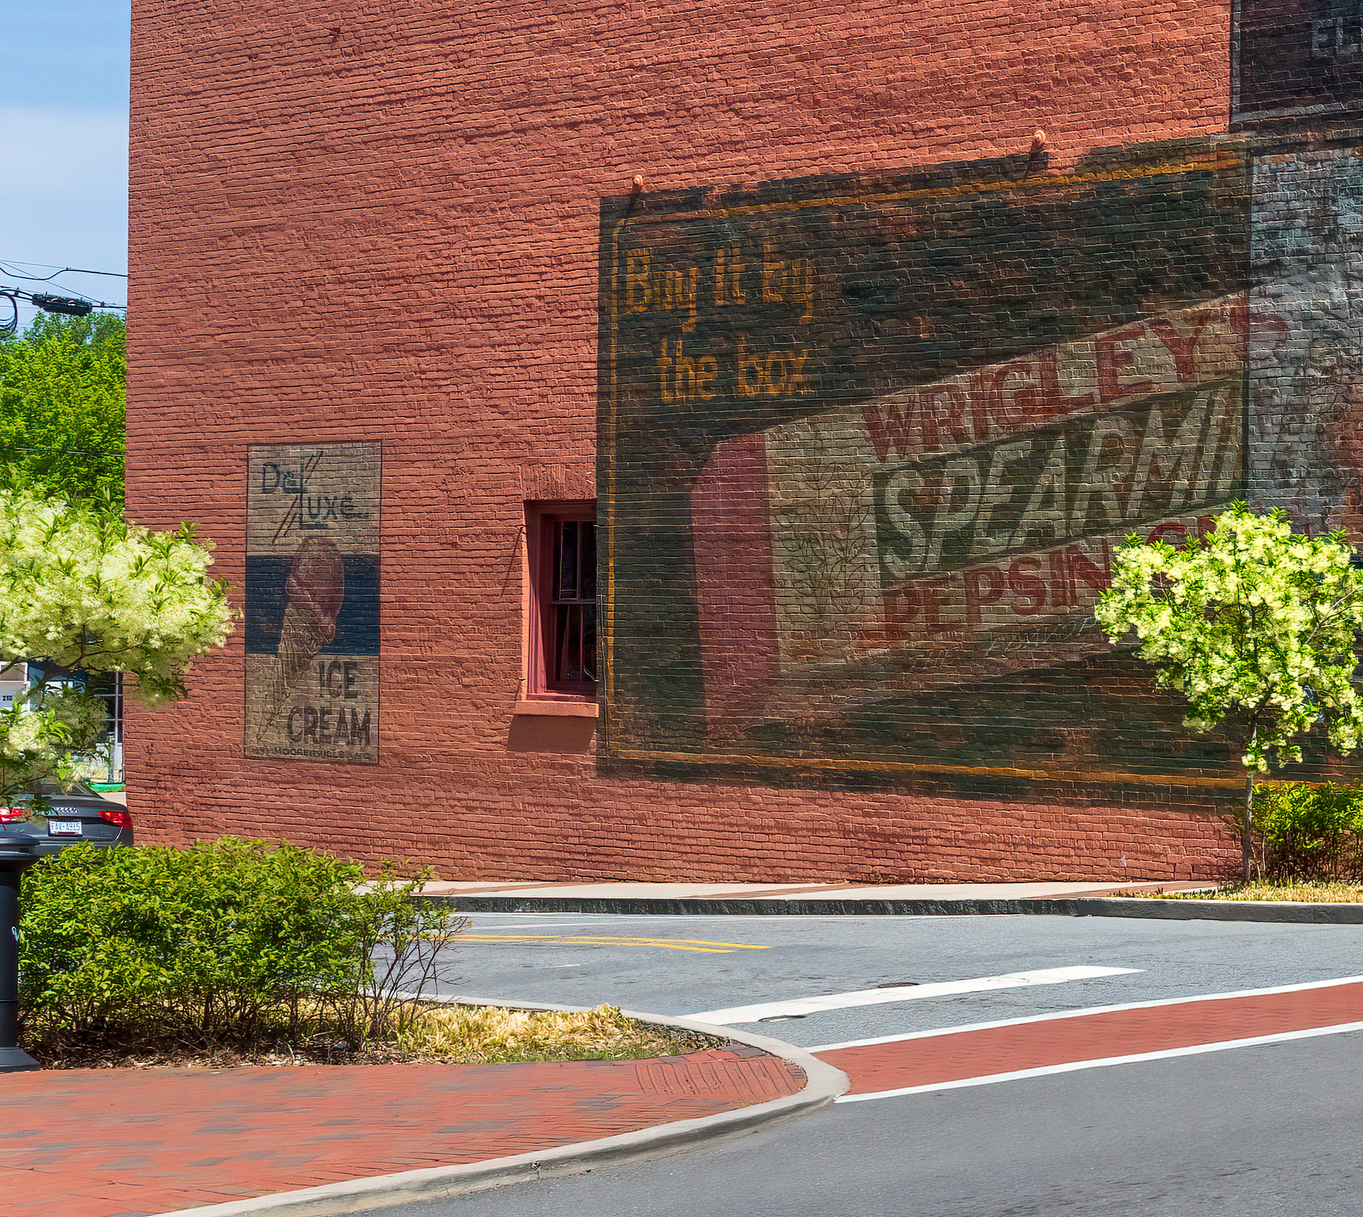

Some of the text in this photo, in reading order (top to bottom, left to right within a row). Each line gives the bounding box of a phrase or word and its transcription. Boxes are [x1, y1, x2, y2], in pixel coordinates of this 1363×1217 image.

[625, 246, 698, 333] Buy
[761, 241, 815, 327] by
[656, 333, 809, 403] the box
[318, 660, 359, 700] ICE
[286, 704, 372, 750] CREAM
